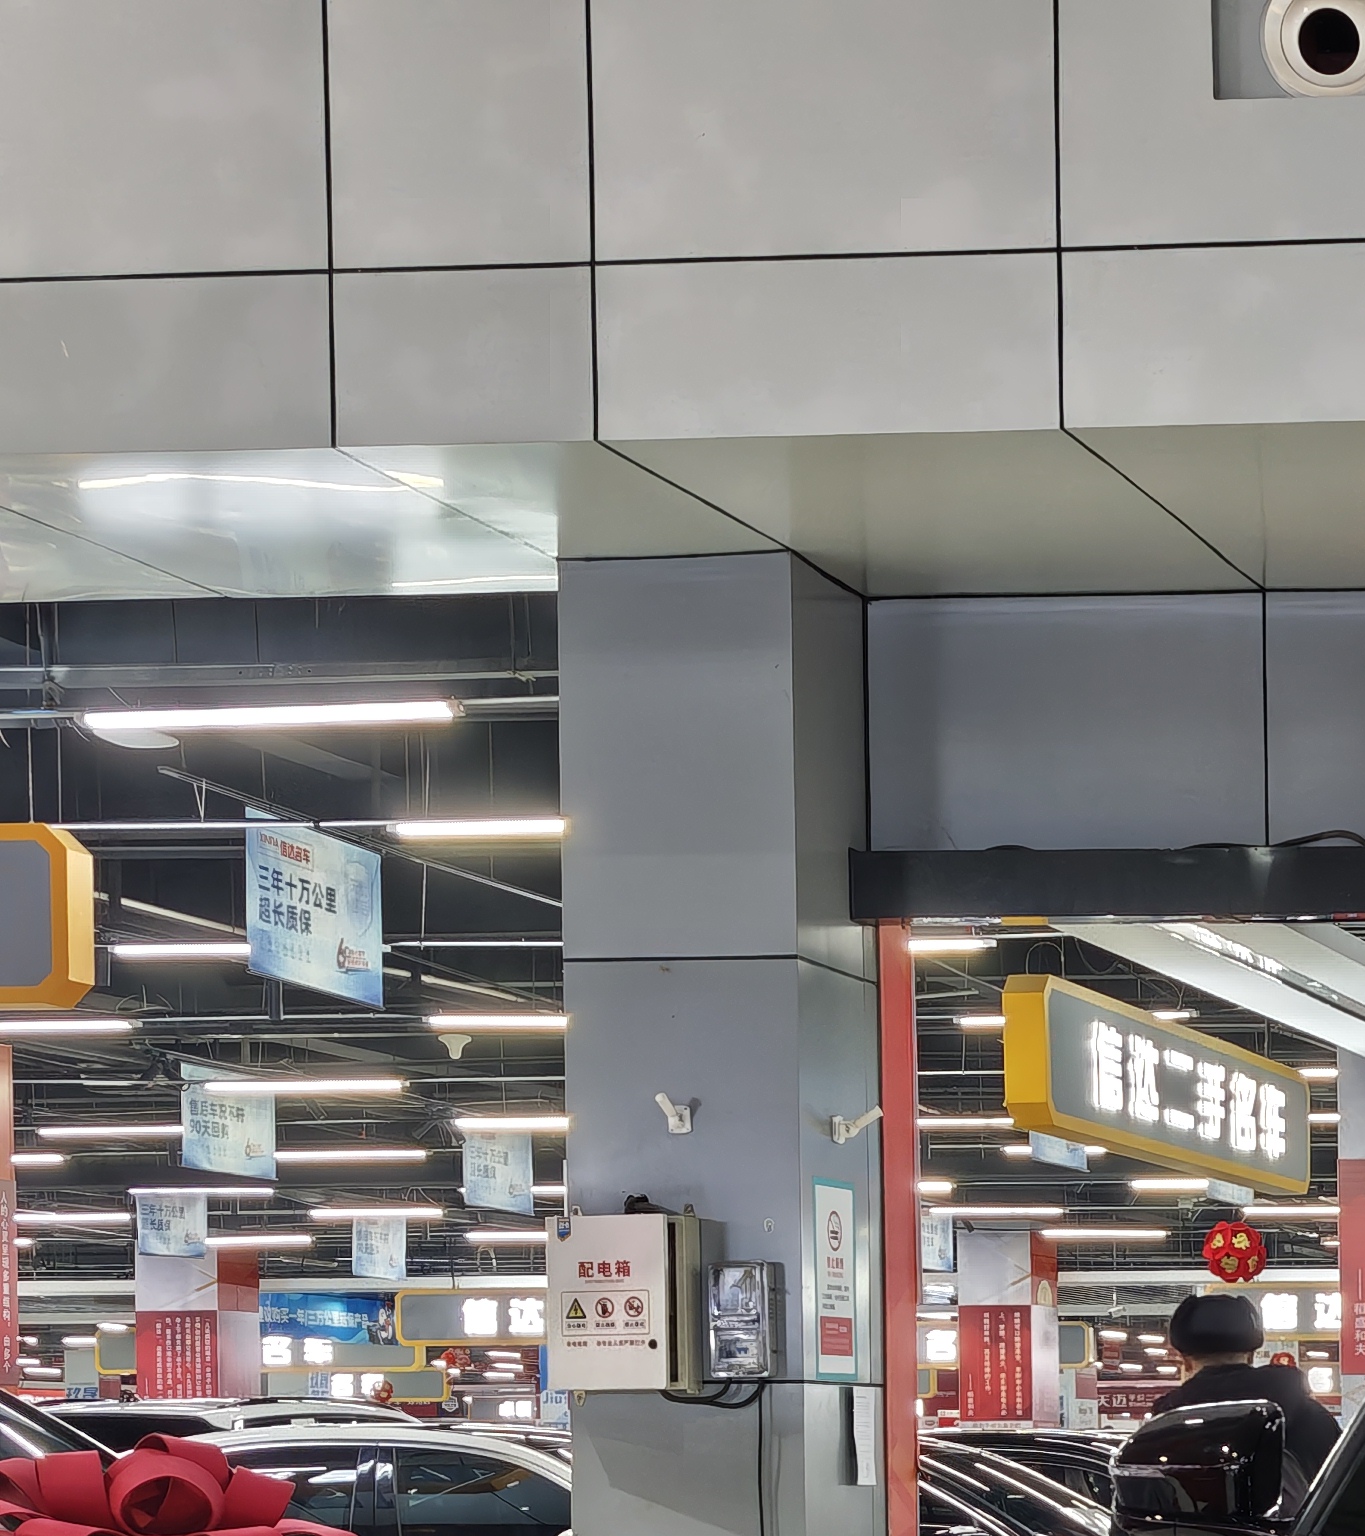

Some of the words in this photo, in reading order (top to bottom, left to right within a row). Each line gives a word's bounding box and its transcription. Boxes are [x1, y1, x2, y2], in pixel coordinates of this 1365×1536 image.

[258, 864, 337, 915] 三年十万公里
[258, 895, 312, 936] 超长质保
[1088, 1020, 1286, 1162] 信达二手名车
[577, 1260, 632, 1279] 配电箱
